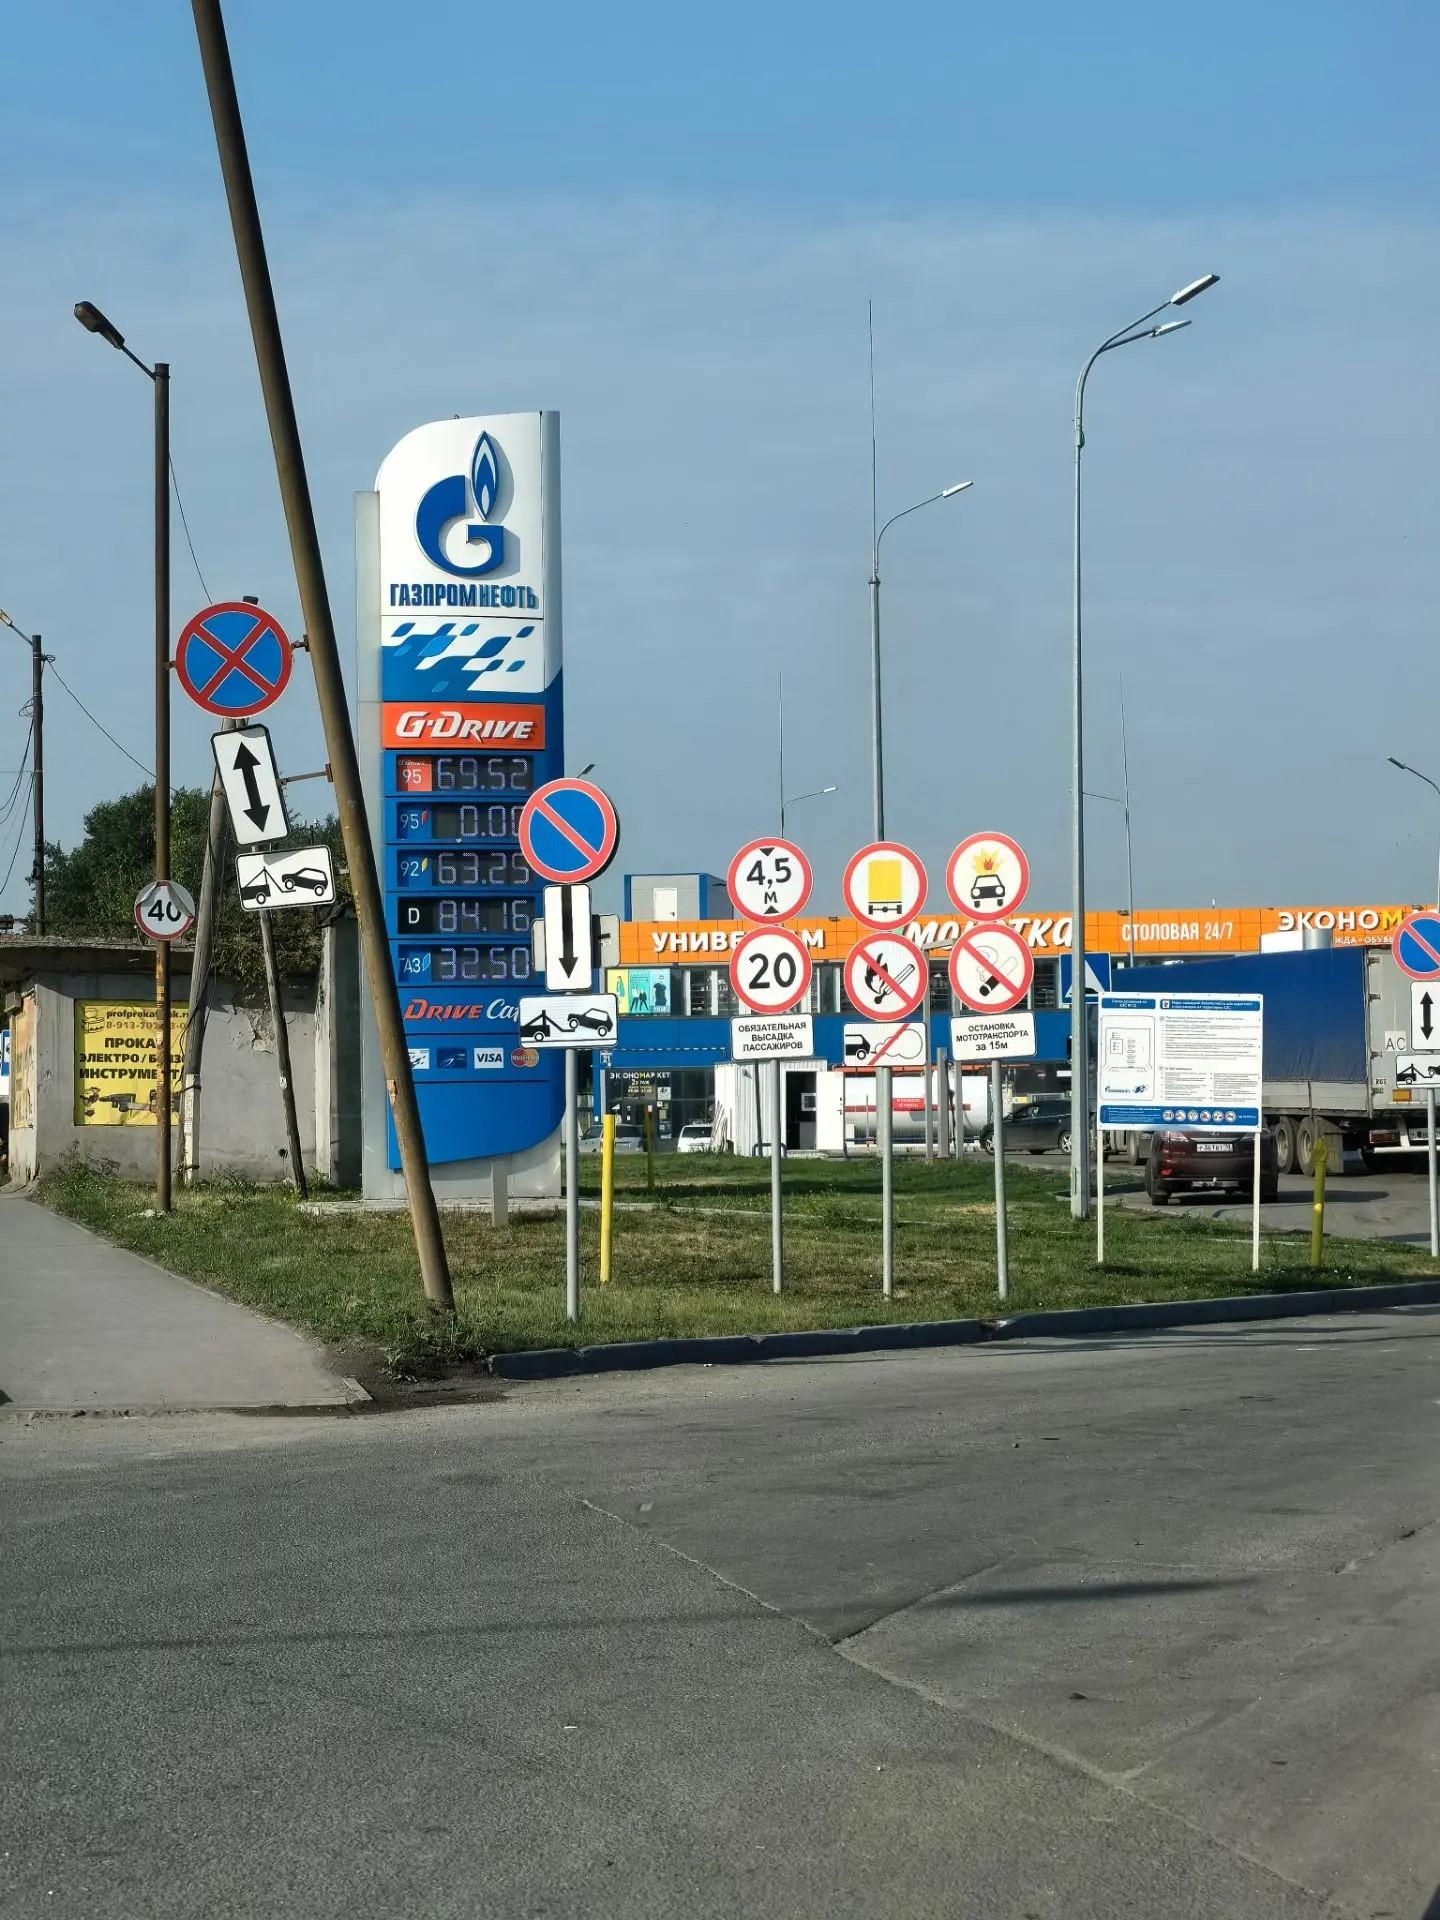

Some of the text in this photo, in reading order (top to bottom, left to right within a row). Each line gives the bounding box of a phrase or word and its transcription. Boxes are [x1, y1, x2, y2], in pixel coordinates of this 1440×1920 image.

[390, 583, 537, 609] ГАЗПРОМНЕФТЬ
[402, 758, 528, 789] 95 69.52
[400, 813, 419, 829] 95
[400, 853, 529, 884] 92 63.25
[746, 858, 792, 889] 4,5
[147, 899, 181, 922] 40
[408, 900, 530, 931] D 84.16
[1278, 909, 1438, 931] ЭКОНОМ
[651, 929, 824, 952] УНИВЕМ
[1122, 921, 1233, 941] СТОЛОВАЯ 24/7
[440, 947, 530, 979] 32.50
[749, 953, 796, 990] 20
[403, 999, 483, 1023] DRIVE
[738, 1022, 806, 1032] ОБЯЗАТЕЛЬНАЯ
[752, 1032, 794, 1042] ВЫСАДКА
[956, 1030, 1029, 1042] МОТОТРАНСПОРТА
[968, 1022, 1015, 1032] ОСТАНОВКА
[105, 1038, 162, 1048] ПРОКА
[743, 1041, 803, 1052] ПАССАЖИРОВ
[477, 1053, 502, 1063] VISA
